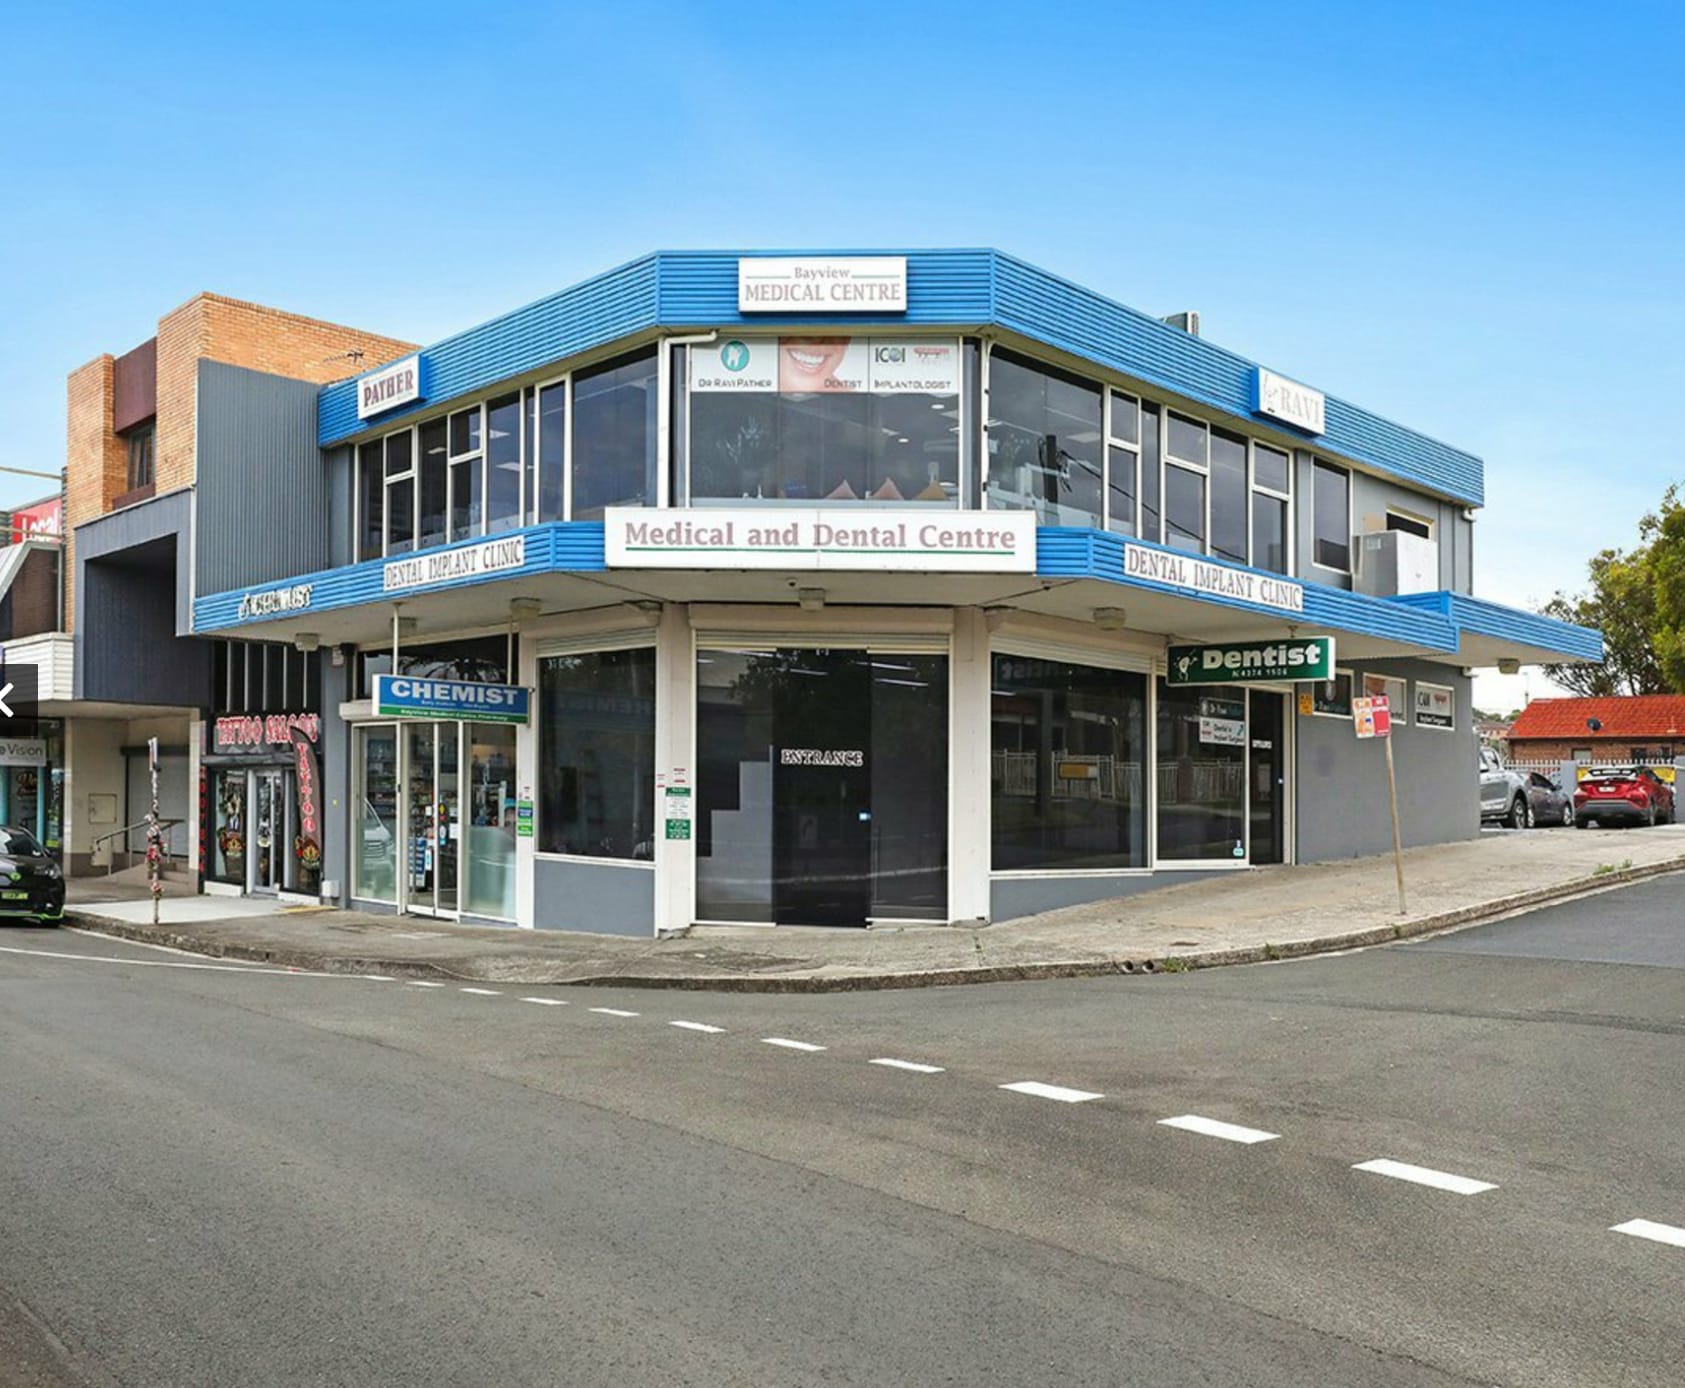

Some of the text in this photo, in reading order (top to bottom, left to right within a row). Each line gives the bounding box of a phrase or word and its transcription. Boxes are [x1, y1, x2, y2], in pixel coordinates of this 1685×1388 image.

[794, 266, 850, 281] Bayview
[745, 283, 901, 302] MEDICAL CENTRE
[363, 369, 414, 409] PATHER
[1280, 386, 1320, 425] RAVI
[625, 521, 1016, 549] Medical and Dental Centre
[385, 539, 522, 588] DENTAL IMPLANT CLINIC
[1128, 548, 1301, 609] DENTAL IMPLANT CLINIC
[1203, 643, 1321, 669] Dentist
[391, 680, 518, 705] CHEMIST
[217, 716, 264, 745] TATTOO
[781, 748, 864, 767] ENTRANCE
